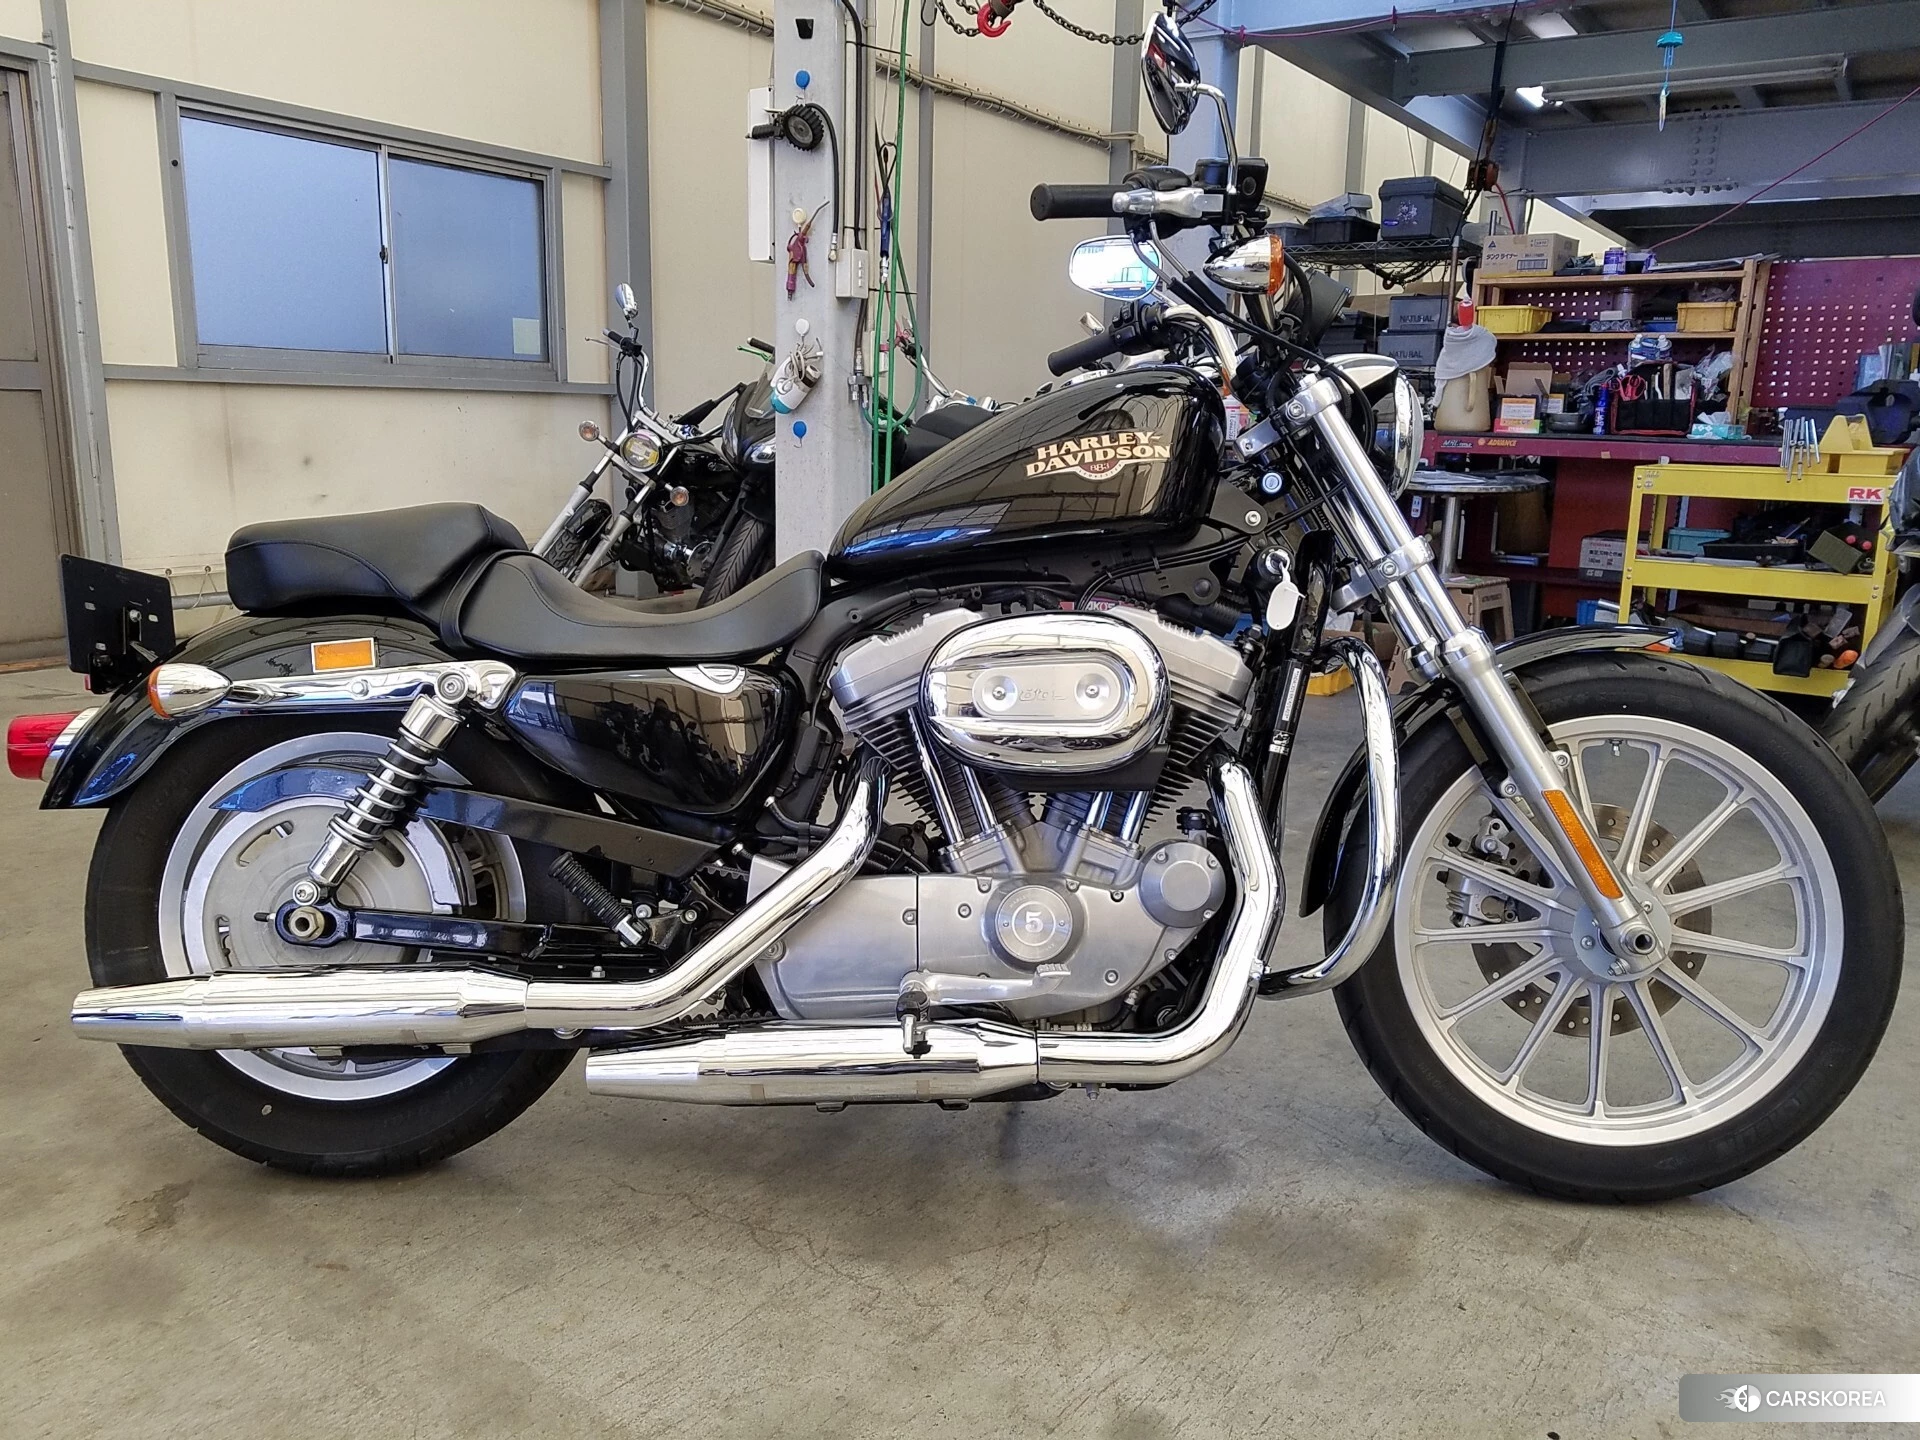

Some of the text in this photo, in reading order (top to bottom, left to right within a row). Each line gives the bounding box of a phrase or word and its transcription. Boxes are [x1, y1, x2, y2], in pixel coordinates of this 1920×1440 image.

[1399, 314, 1435, 323] NATURAL
[1388, 350, 1424, 359] NATURAL
[1037, 431, 1161, 460] HARLEY-
[1026, 445, 1170, 476] DAVIDSON
[1089, 462, 1110, 472] 883
[1849, 487, 1883, 500] RK
[1025, 911, 1043, 933] 5
